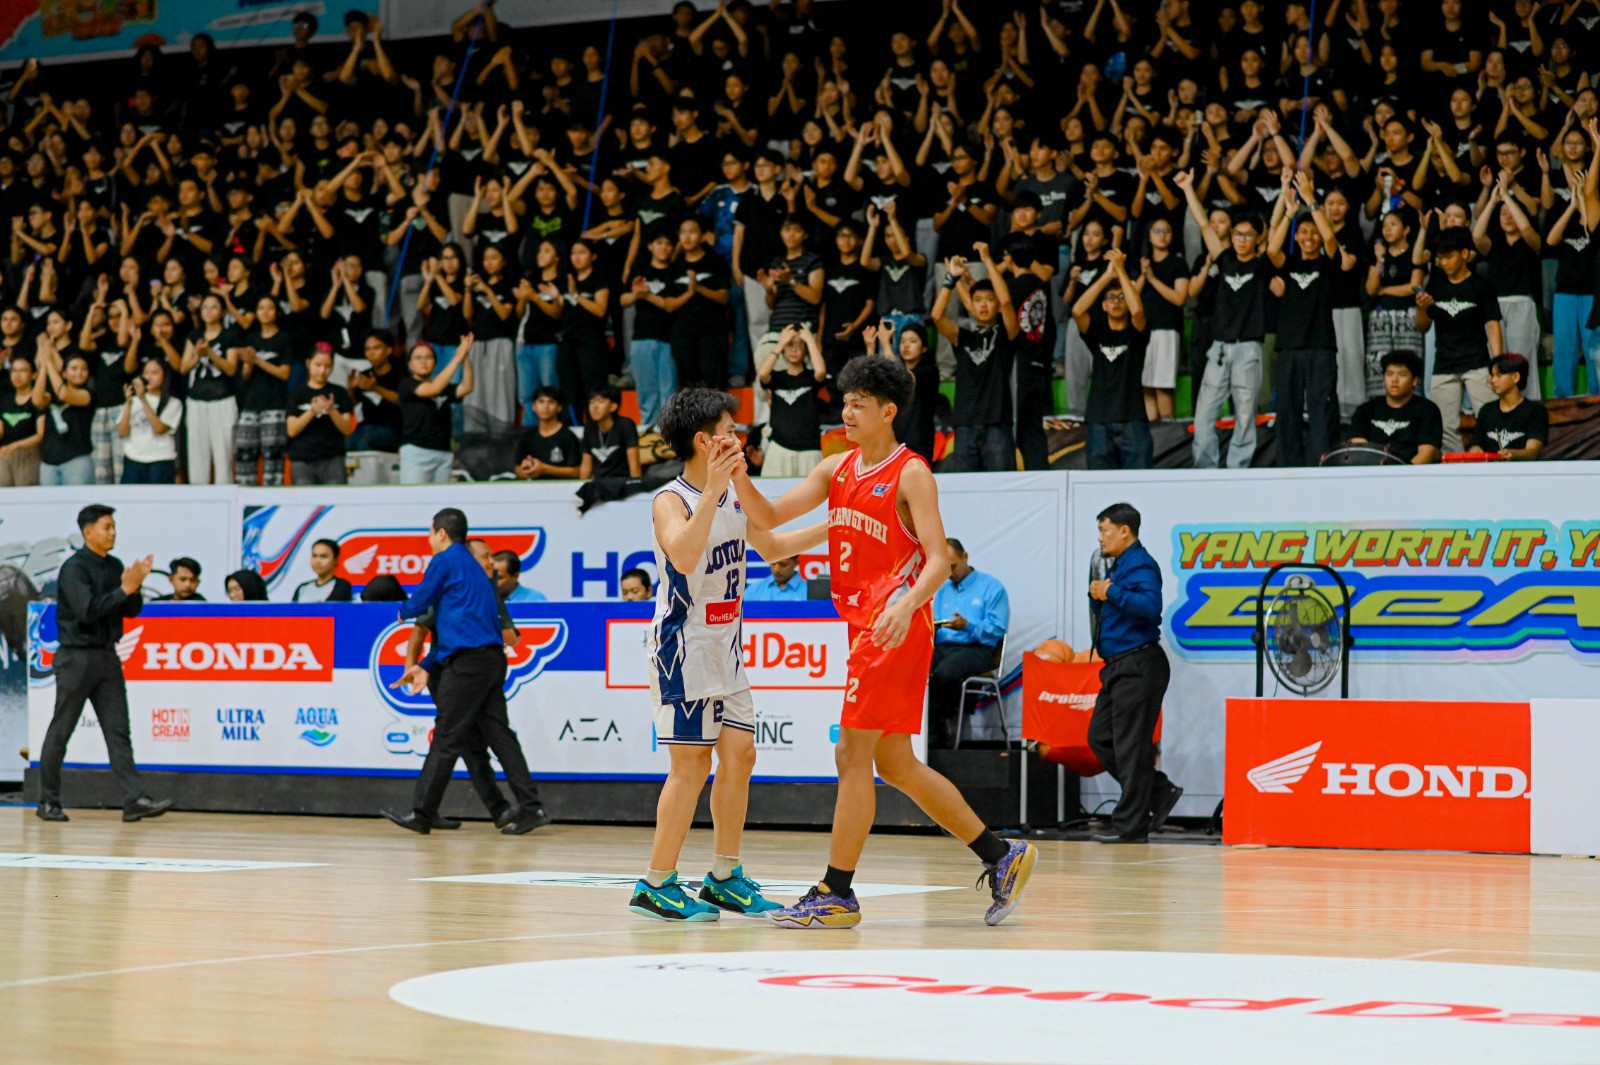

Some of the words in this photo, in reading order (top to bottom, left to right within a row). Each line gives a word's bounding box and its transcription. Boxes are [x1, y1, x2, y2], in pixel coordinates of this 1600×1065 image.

[840, 541, 852, 572] 2
[1179, 531, 1308, 568] YANG
[1314, 529, 1491, 567] WORTH
[724, 568, 739, 600] 12
[143, 642, 323, 670] HONDA
[763, 632, 827, 678] Day
[846, 677, 859, 703] 2
[152, 709, 175, 722] HOT
[217, 708, 266, 724] ULTRA
[295, 707, 338, 728] AQUA
[152, 725, 190, 737] CREAM
[221, 726, 260, 740] MILK
[1321, 763, 1531, 799] HOND
